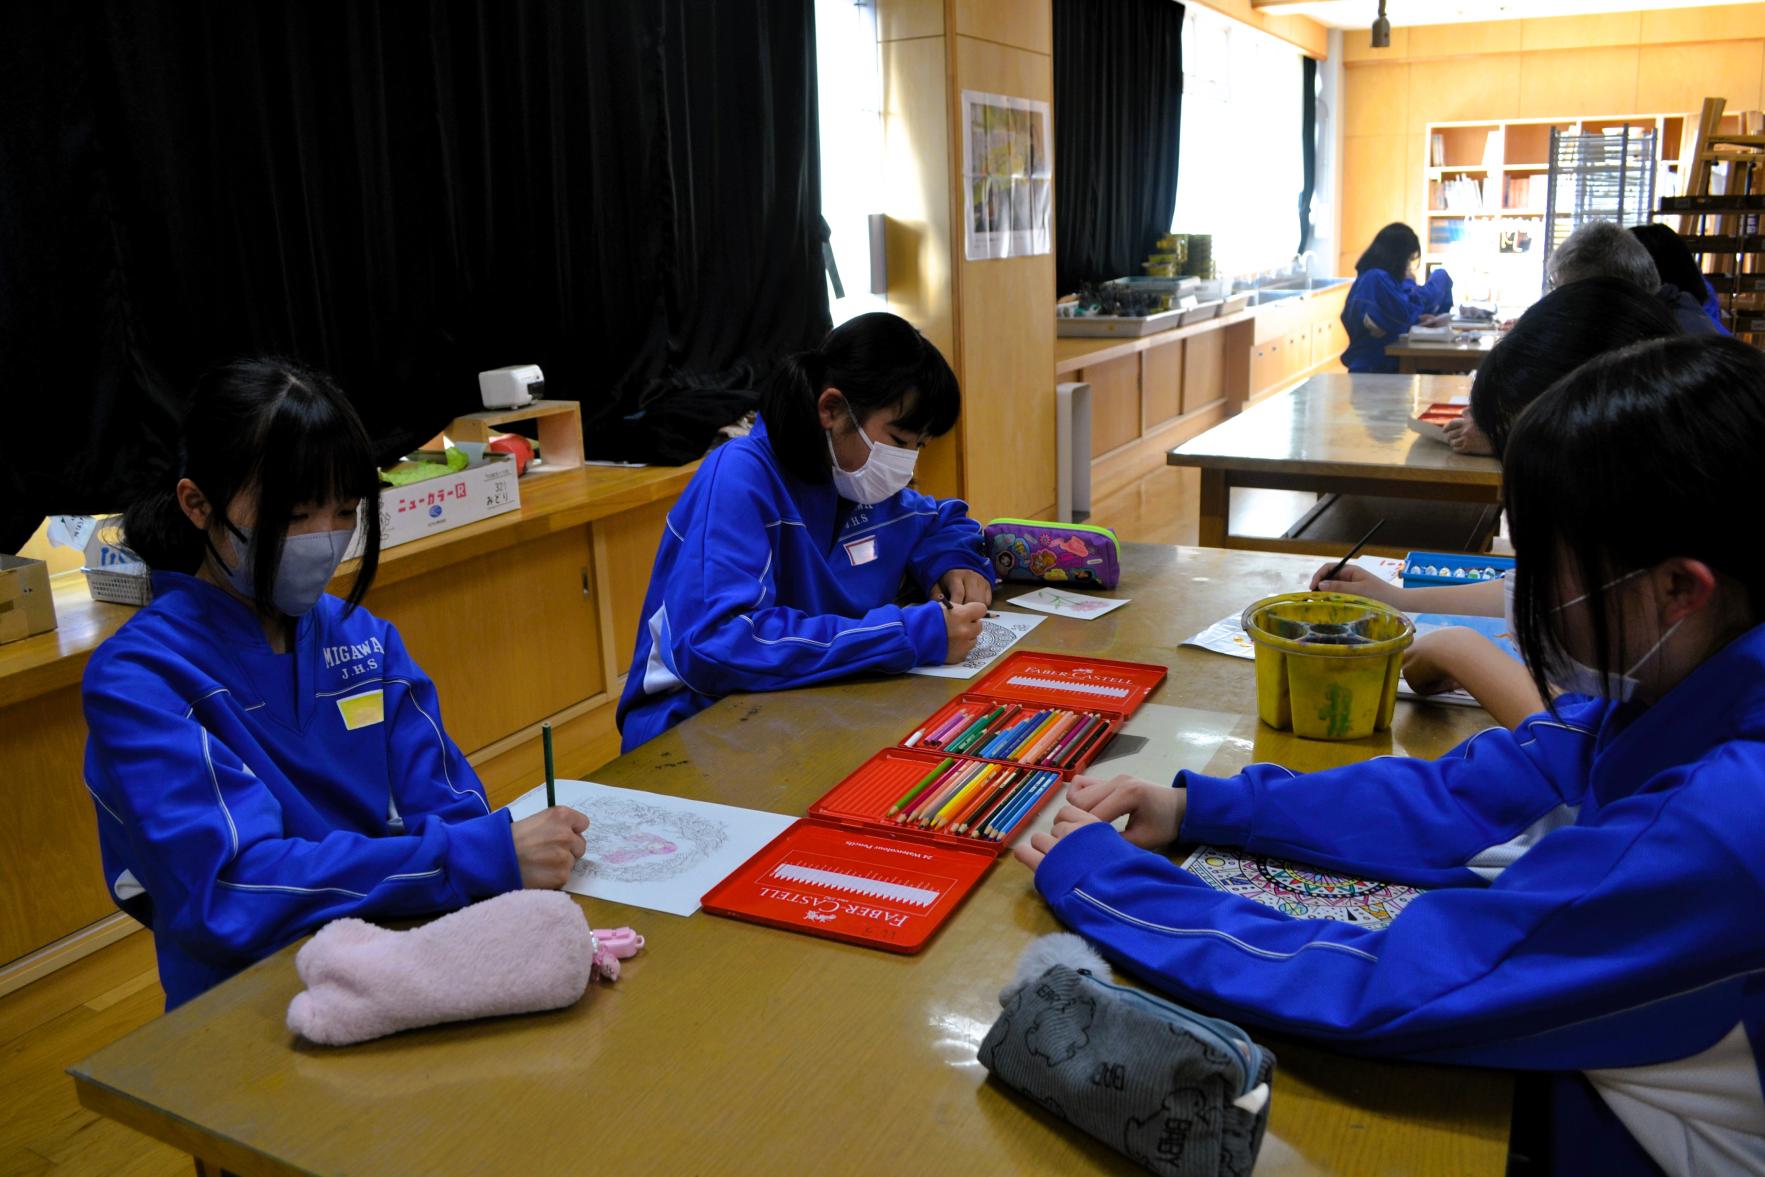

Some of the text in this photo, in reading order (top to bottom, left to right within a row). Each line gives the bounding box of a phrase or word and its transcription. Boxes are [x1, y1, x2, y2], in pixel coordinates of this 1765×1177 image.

[322, 636, 385, 669] MIGAWA
[845, 840, 873, 849] Pencils
[759, 887, 910, 927] FABER-CASTELL
